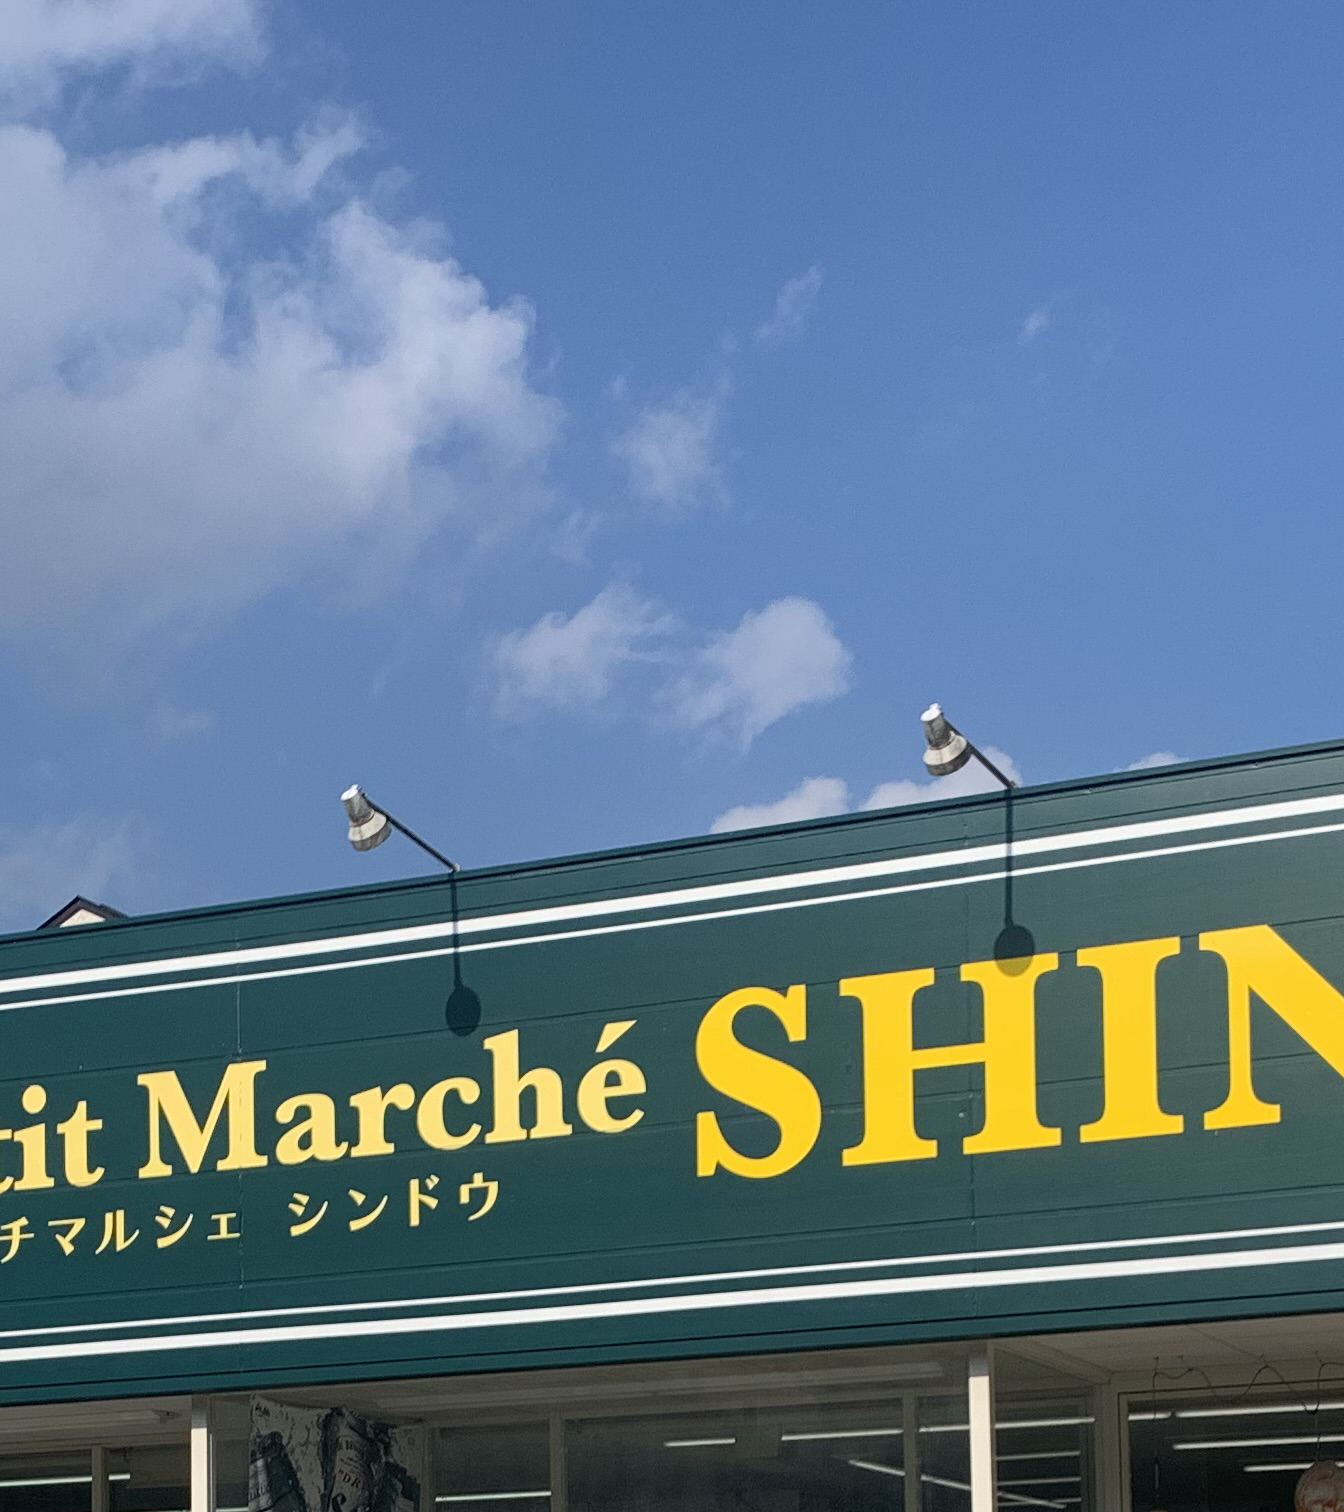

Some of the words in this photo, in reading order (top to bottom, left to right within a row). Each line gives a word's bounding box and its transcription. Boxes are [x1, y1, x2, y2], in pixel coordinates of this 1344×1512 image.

[136, 1020, 648, 1181] Marché
[287, 1171, 501, 1238] シンドウ
